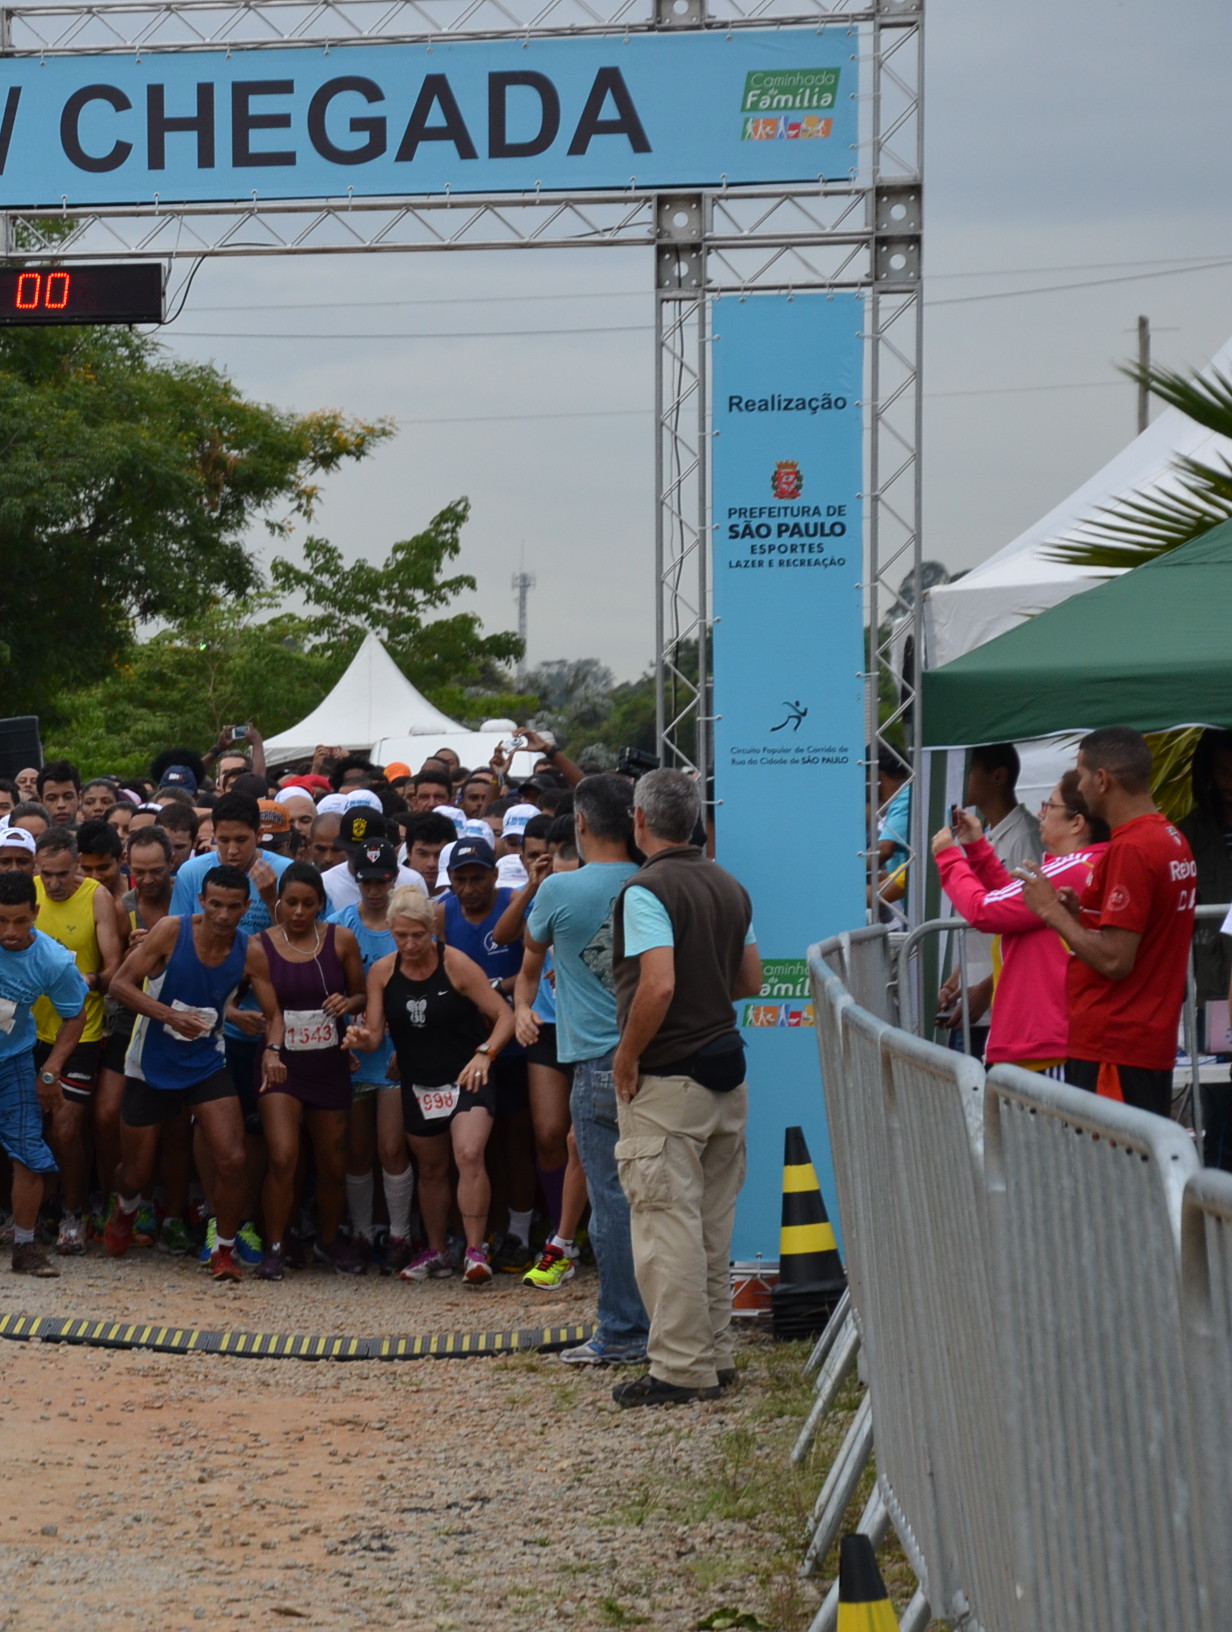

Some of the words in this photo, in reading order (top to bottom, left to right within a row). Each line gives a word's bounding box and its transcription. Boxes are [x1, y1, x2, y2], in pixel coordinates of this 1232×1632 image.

[751, 72, 836, 88] Caminhada
[746, 88, 832, 110] Família
[60, 62, 652, 173] CHEGADA
[16, 272, 70, 309] 00
[729, 393, 846, 414] Realização
[728, 506, 821, 518] PREFEITURA
[827, 505, 846, 516] DE
[729, 520, 771, 539] SÃO
[777, 522, 846, 538] PAULO
[751, 543, 824, 554] ESPORTES
[728, 559, 765, 569] LAZER
[768, 559, 774, 568] E
[779, 558, 845, 568] RECREAÇÃO
[729, 746, 761, 755] Circuito
[762, 746, 792, 756] Popular
[794, 746, 805, 754] de
[806, 745, 837, 754] Corrida
[838, 745, 849, 753] de
[731, 758, 746, 766] Rua
[747, 757, 758, 766] da
[759, 756, 788, 765] Cidade
[789, 757, 800, 765] de
[801, 755, 820, 765] SÃO
[821, 756, 849, 764] PAULO
[759, 977, 811, 997] amíl
[286, 1024, 333, 1045] 1543
